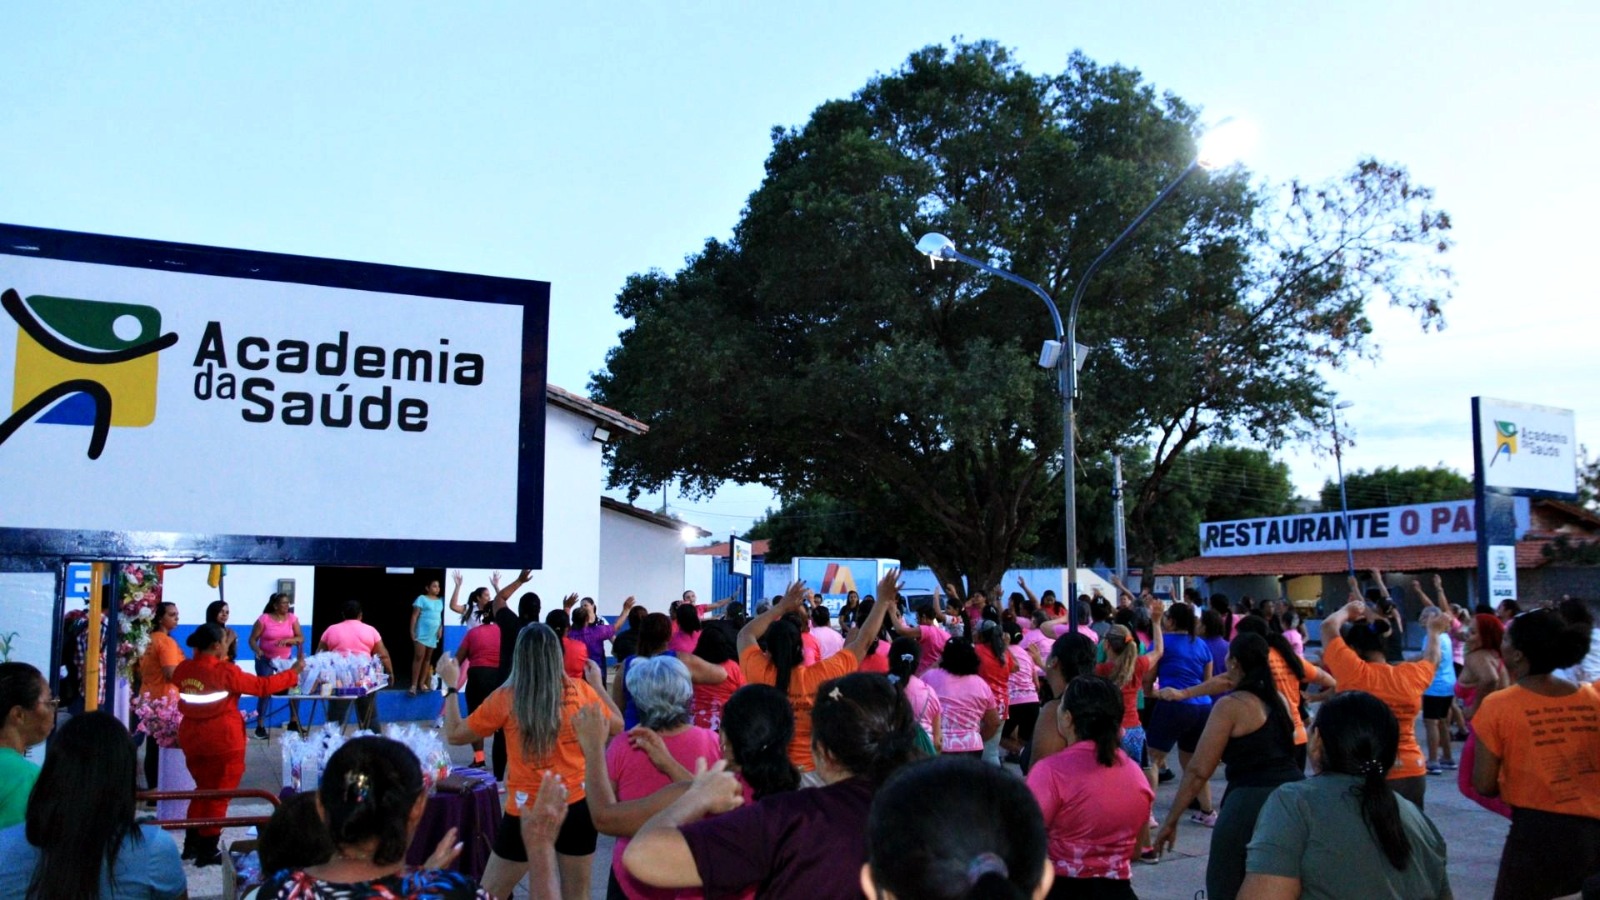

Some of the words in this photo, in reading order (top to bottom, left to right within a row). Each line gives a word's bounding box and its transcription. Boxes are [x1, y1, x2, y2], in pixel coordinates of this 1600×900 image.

[193, 321, 485, 386] Academia
[194, 362, 236, 401] da
[241, 378, 428, 432] Saúde
[1205, 511, 1390, 549] RESTAURANTE
[1400, 510, 1420, 536] O
